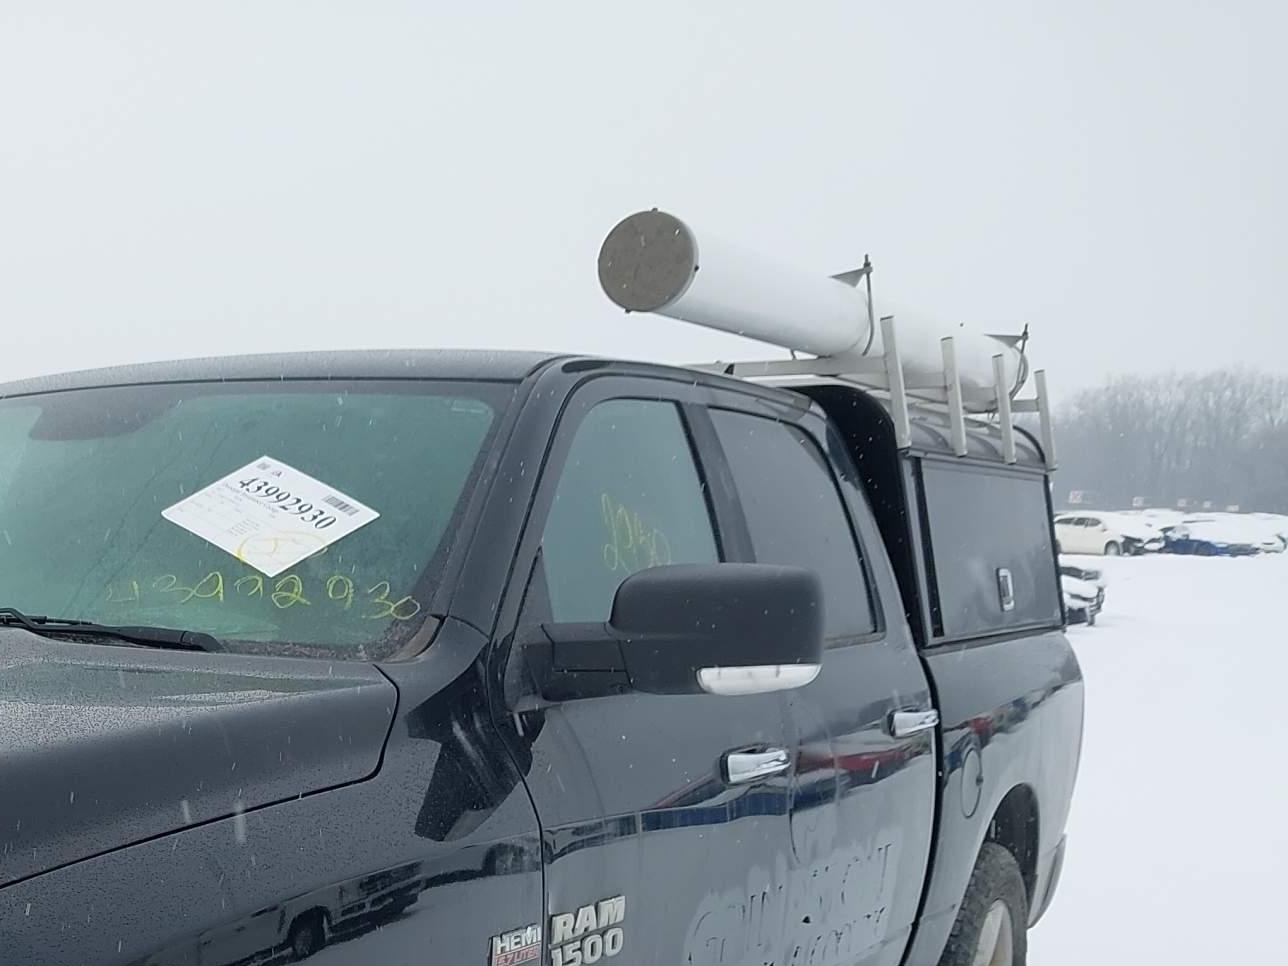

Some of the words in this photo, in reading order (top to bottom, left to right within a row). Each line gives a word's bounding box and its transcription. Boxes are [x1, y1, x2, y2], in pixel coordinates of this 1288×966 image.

[239, 476, 337, 529] 43992930
[493, 925, 542, 955] HEMI
[551, 896, 625, 945] RAM
